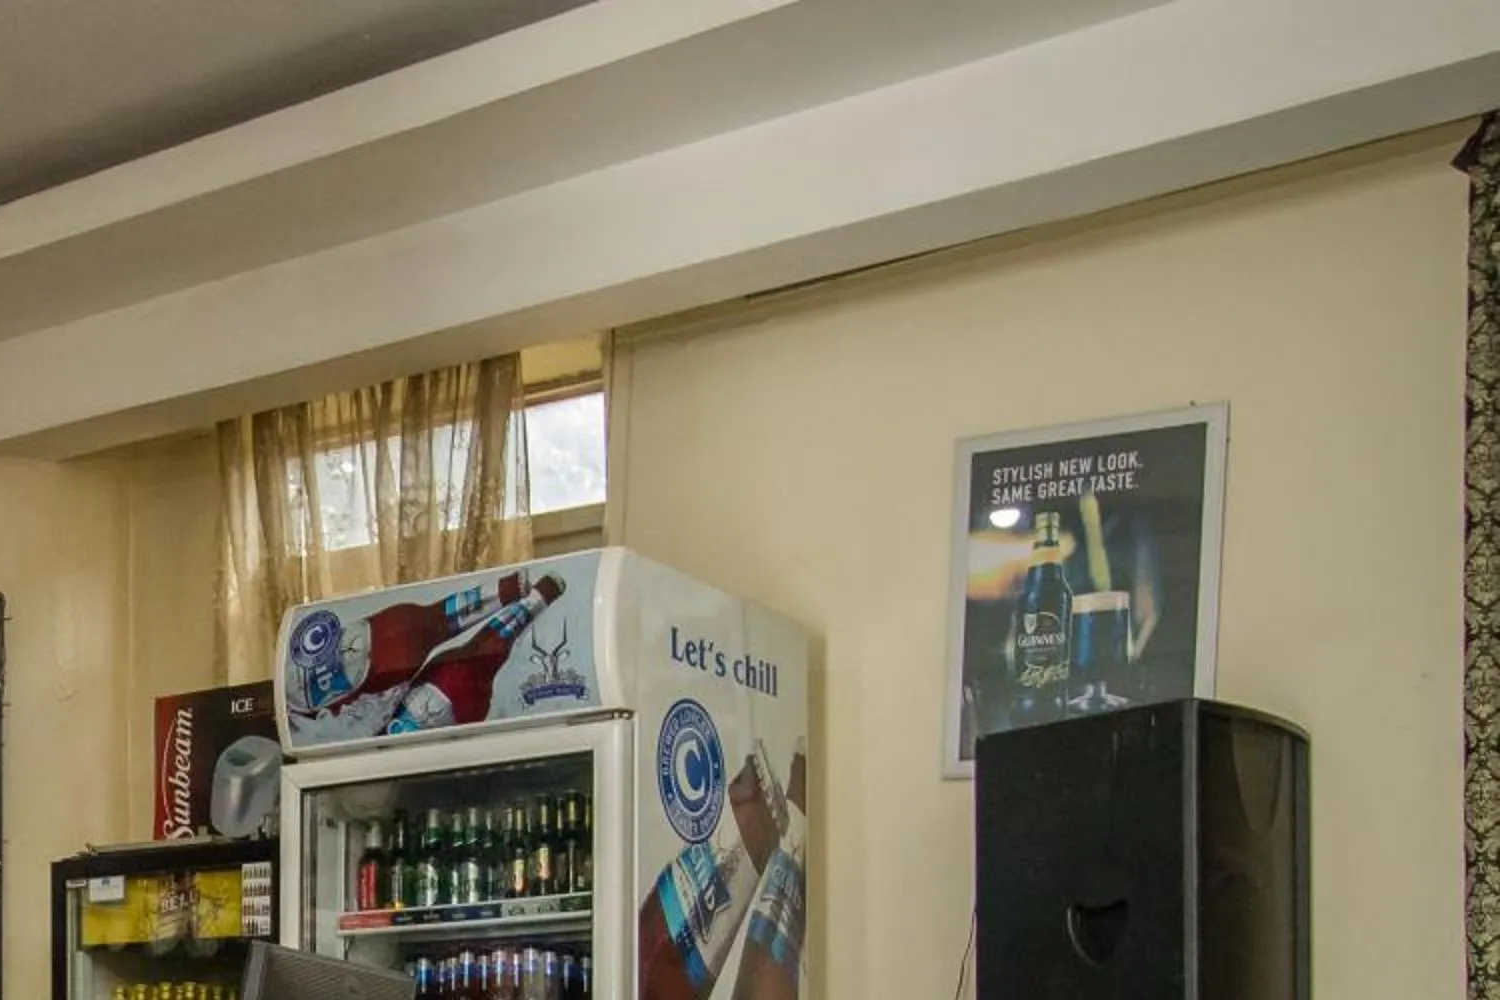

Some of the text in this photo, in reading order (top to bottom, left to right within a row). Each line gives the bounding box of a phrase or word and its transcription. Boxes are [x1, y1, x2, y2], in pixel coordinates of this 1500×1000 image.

[992, 451, 1143, 486] STYLISH NEW LOOK.
[991, 472, 1140, 505] SAME GREAT TASTE.
[670, 626, 778, 697] Let's chill
[231, 698, 254, 713] ICE
[163, 709, 194, 841] Sunbeam
